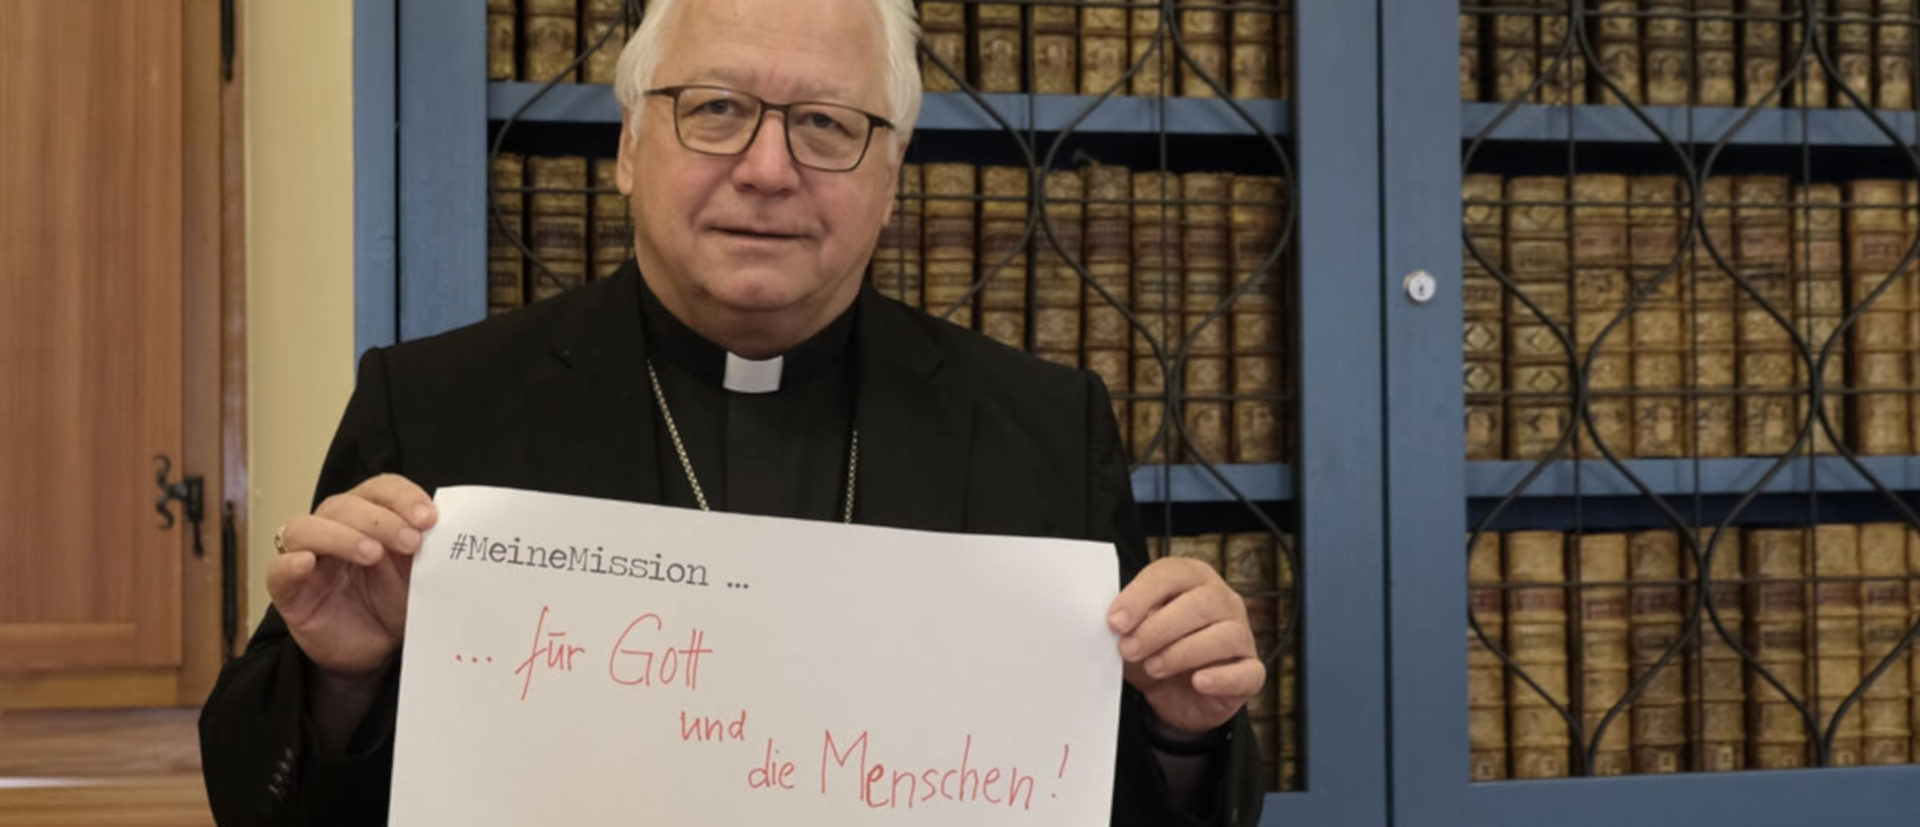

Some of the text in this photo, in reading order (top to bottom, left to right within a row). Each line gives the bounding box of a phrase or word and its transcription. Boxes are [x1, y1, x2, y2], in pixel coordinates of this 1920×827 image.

[449, 532, 708, 589] #MeineMission
[609, 612, 713, 690] Gott
[680, 710, 747, 742] und
[747, 738, 796, 790] die
